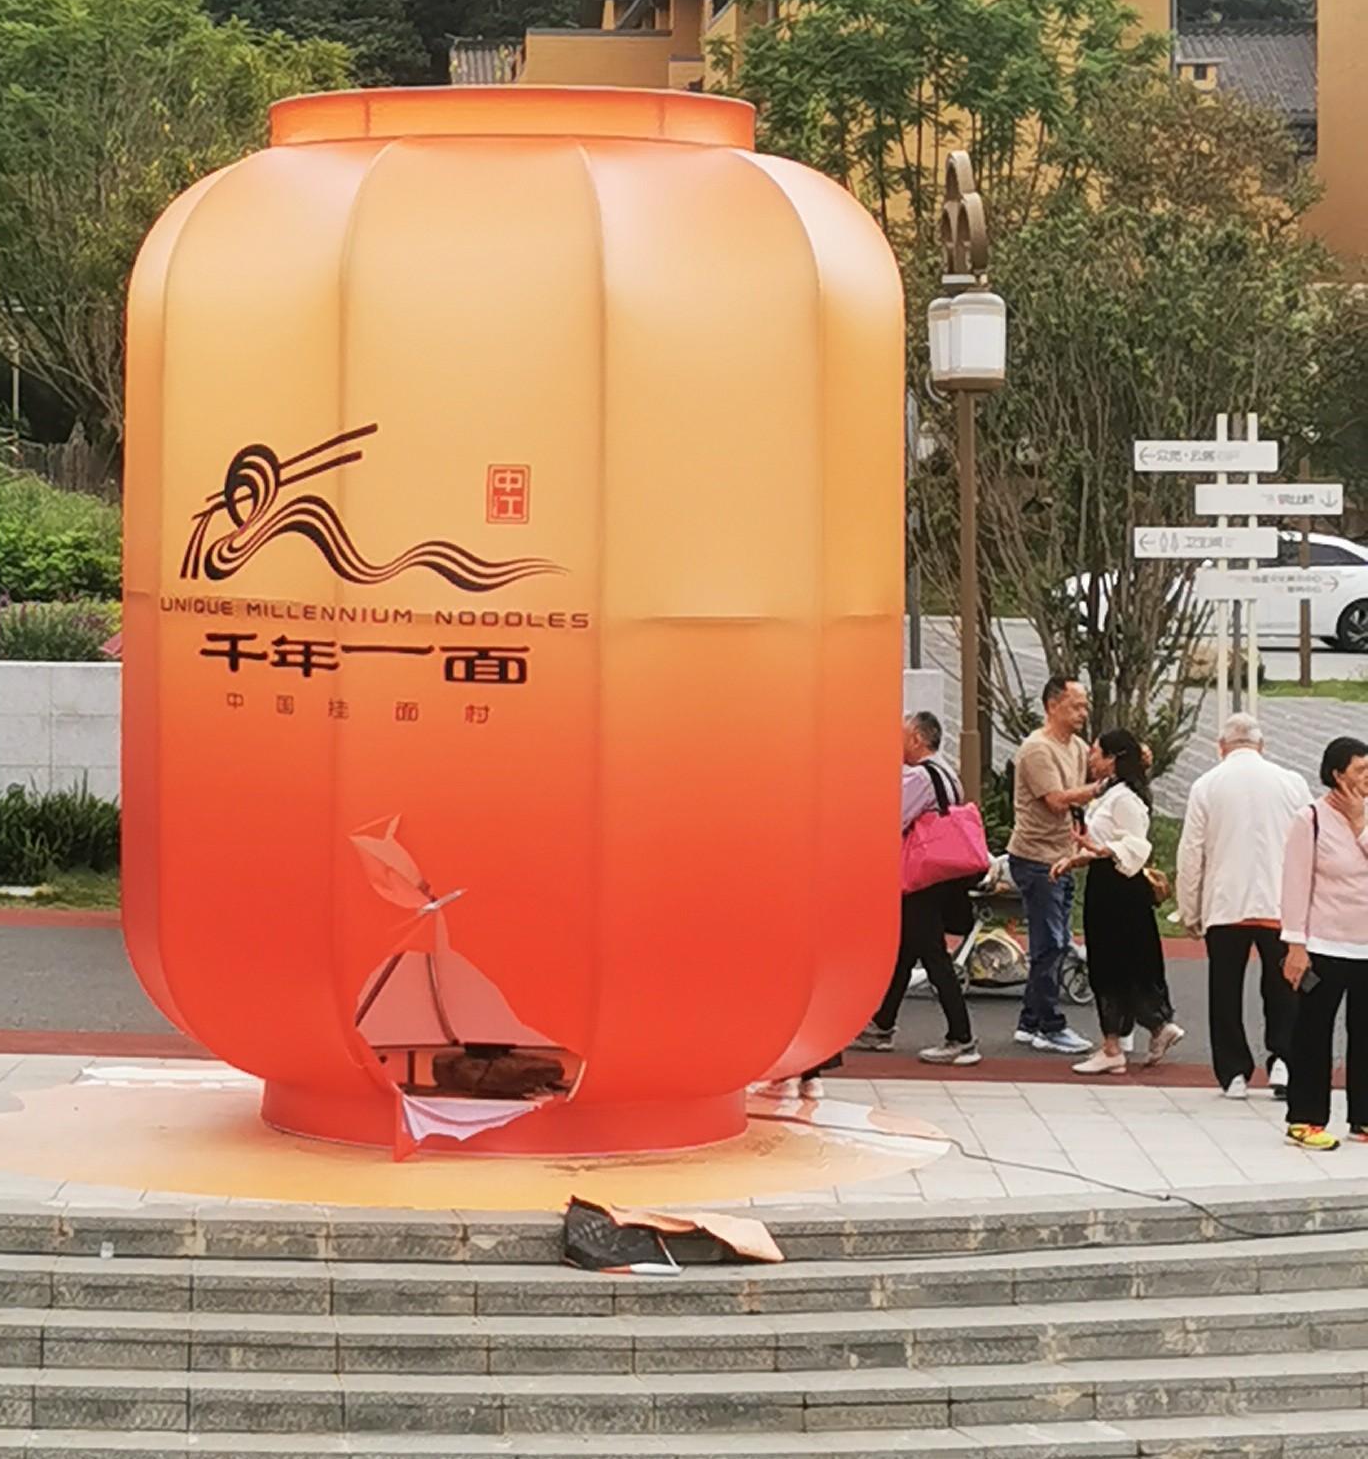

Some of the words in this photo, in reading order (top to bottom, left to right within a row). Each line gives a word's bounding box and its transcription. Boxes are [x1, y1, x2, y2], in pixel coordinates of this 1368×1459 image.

[160, 597, 233, 616] UNIQUE
[246, 602, 413, 624] MILLENNIUM
[435, 610, 589, 629] NOODLES
[199, 632, 531, 684] 千年一面
[226, 691, 491, 725] 中国挂面村
